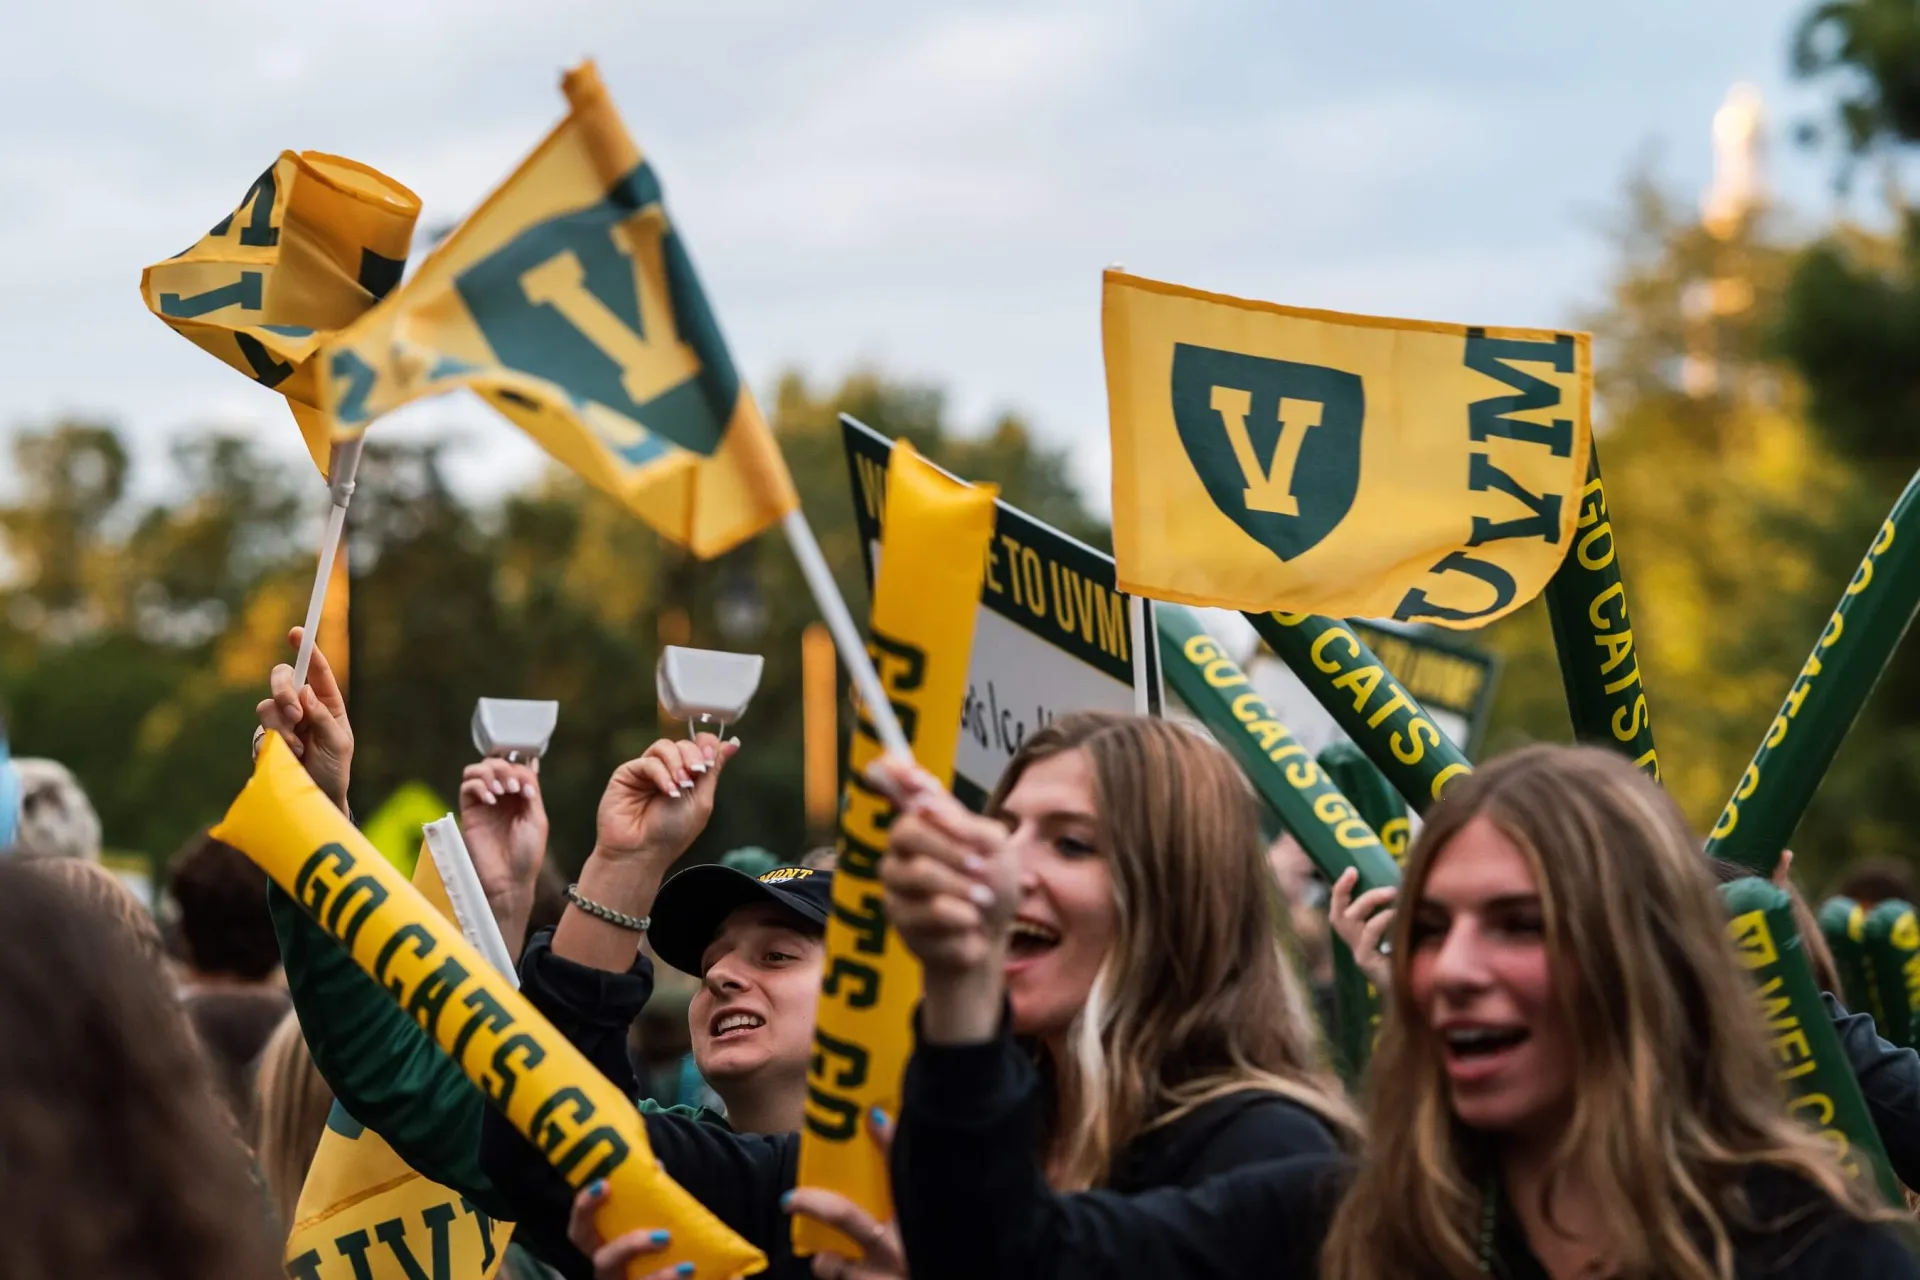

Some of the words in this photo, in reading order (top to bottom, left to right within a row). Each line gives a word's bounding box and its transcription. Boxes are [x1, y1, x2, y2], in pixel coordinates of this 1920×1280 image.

[519, 204, 702, 405] V
[1210, 386, 1324, 517] V
[1393, 328, 1576, 622] UVM
[1577, 477, 1616, 571] GO
[1002, 534, 1046, 617] TO
[1049, 560, 1128, 663] UVM
[1589, 581, 1649, 742] CATS
[1183, 634, 1248, 688] GO
[1231, 693, 1330, 789] CATS
[1313, 793, 1381, 849] GO
[1310, 627, 1440, 766] CATS
[296, 842, 389, 950] GO
[375, 923, 547, 1103] CATS
[531, 1086, 630, 1191] GO
[806, 1025, 871, 1143] GO
[285, 1197, 497, 1280] UV
